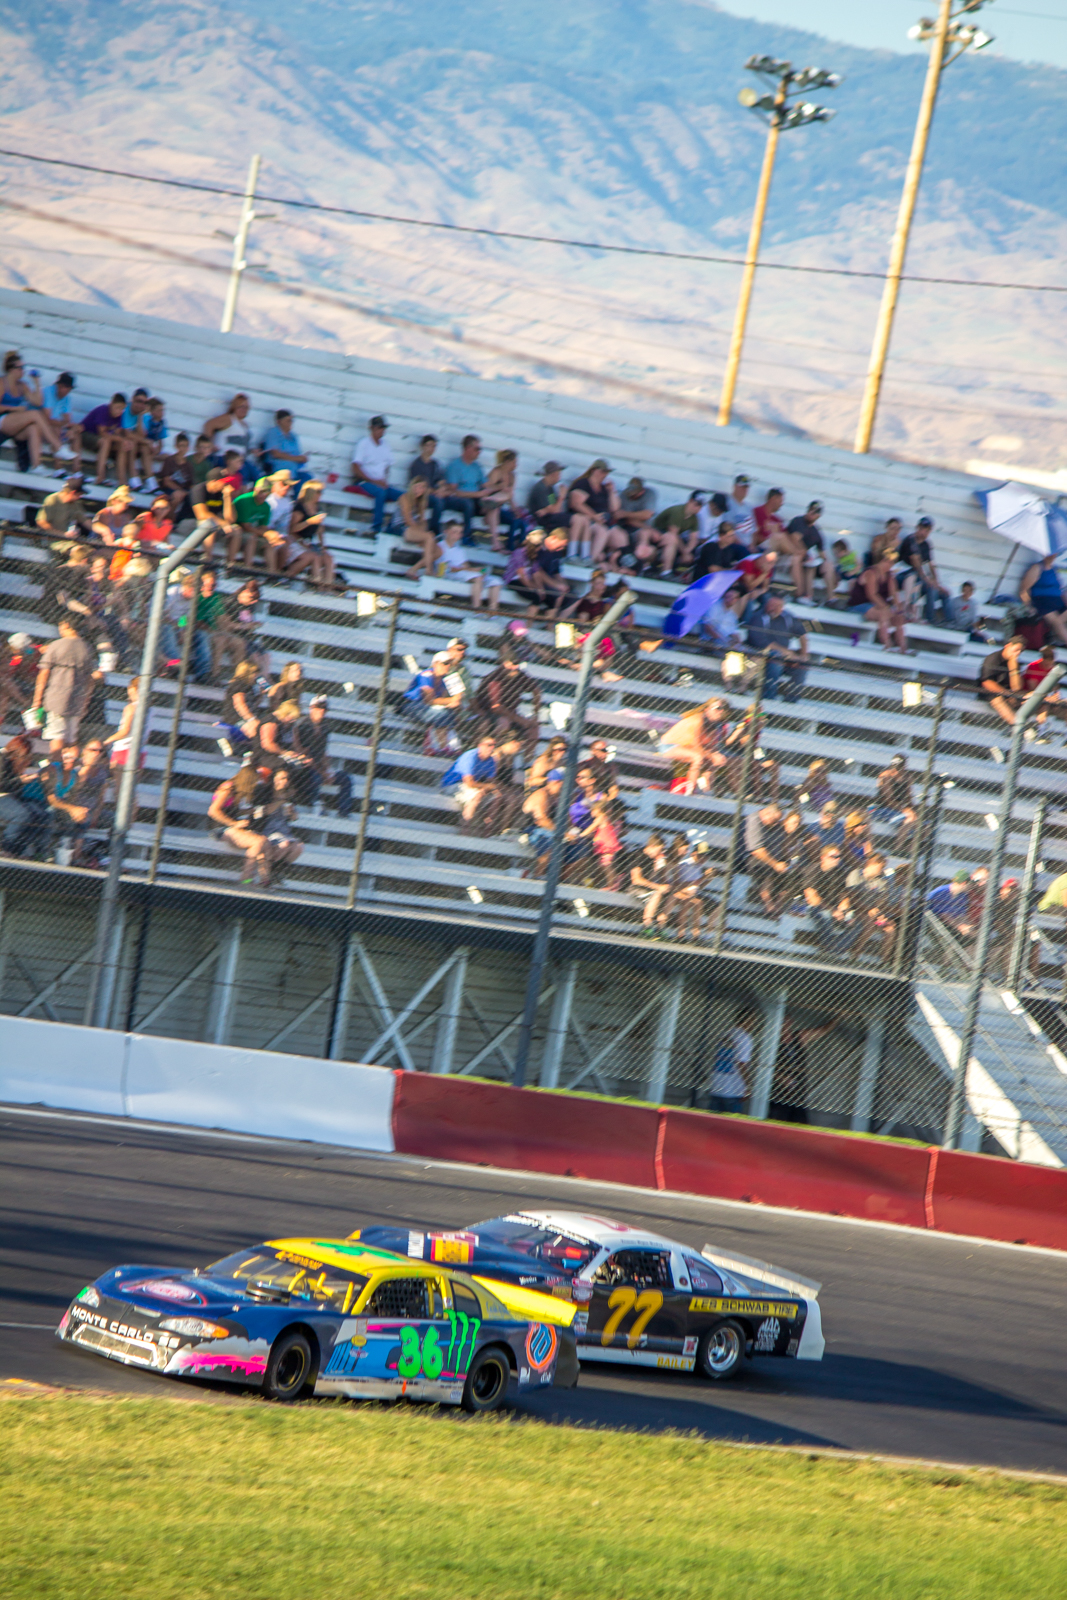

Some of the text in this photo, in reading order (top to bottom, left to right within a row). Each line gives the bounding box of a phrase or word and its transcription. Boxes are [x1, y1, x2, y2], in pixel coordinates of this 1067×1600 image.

[71, 1304, 108, 1330] MONTE
[109, 1320, 154, 1344] CARLO
[601, 1285, 663, 1349] 77
[657, 1356, 695, 1370] BAILEY
